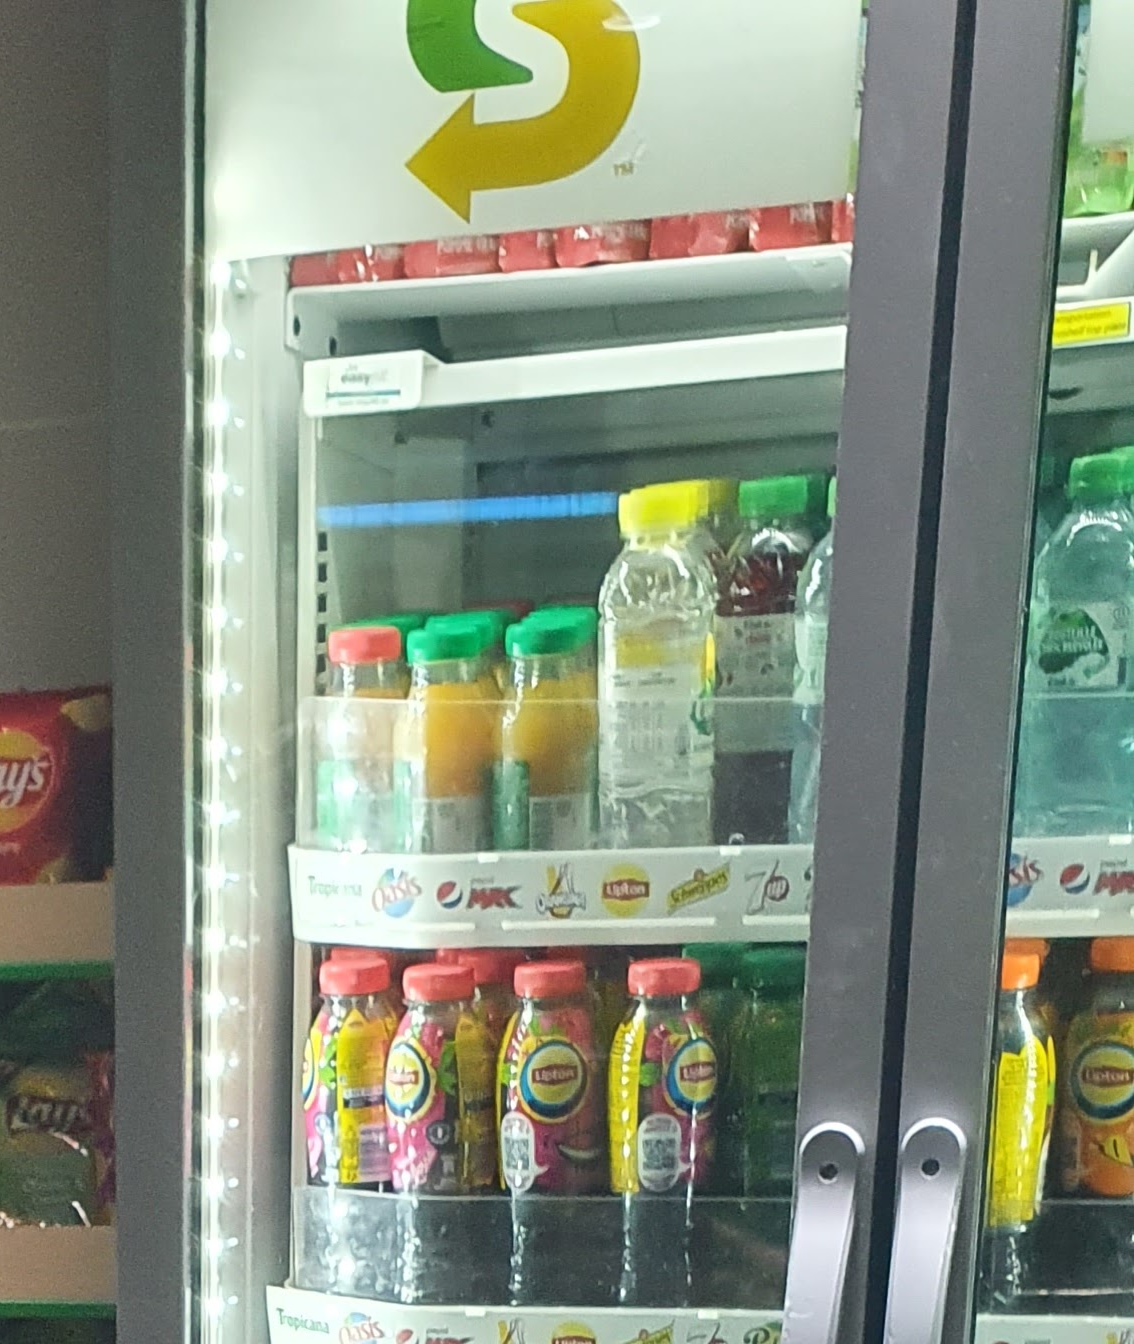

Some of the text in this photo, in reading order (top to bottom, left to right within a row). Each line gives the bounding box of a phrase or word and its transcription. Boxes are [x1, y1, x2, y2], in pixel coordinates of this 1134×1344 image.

[604, 882, 648, 899] Lipton
[534, 1068, 575, 1083] Lipton
[276, 1308, 330, 1334] Tropicana
